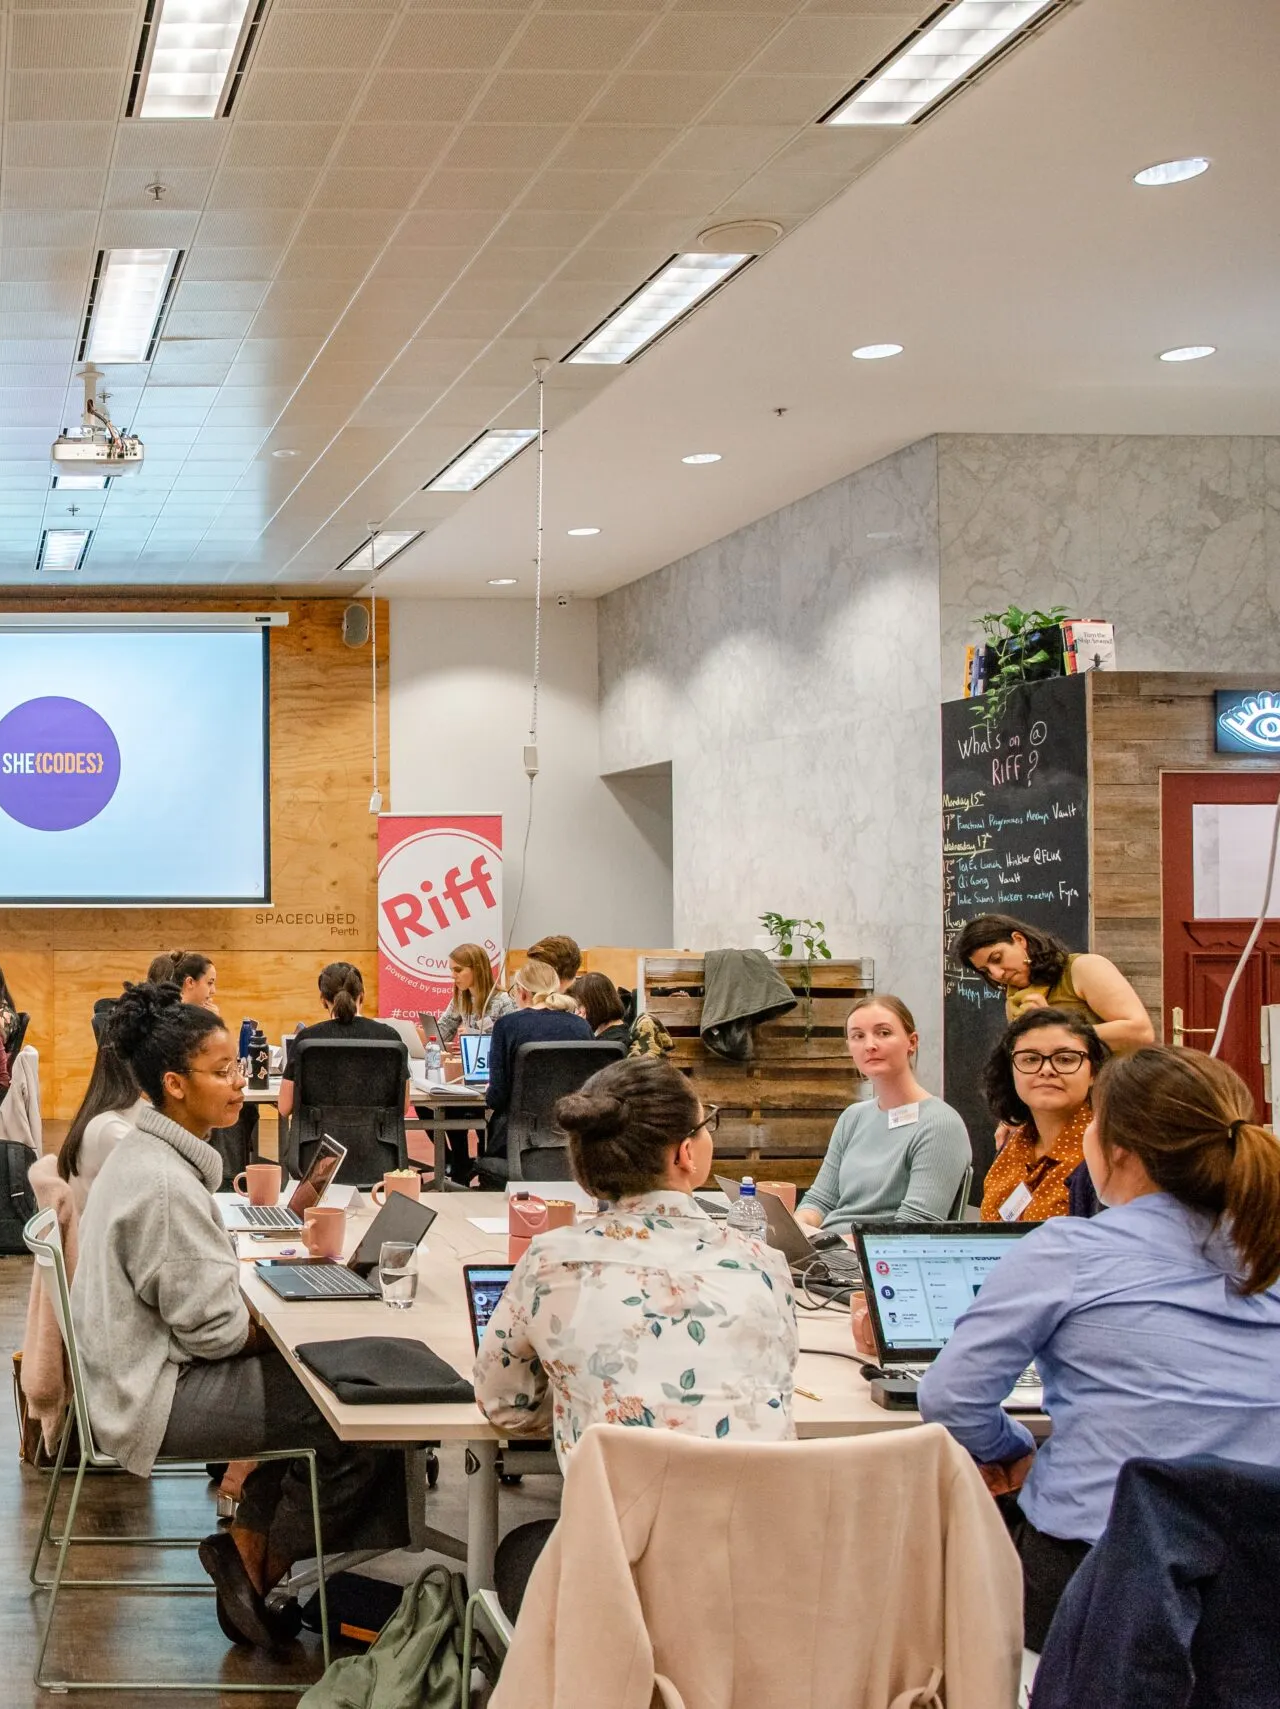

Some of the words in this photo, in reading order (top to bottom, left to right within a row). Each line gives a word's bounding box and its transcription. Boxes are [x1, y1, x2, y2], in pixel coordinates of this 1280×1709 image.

[1009, 735, 1020, 747] on
[2, 752, 104, 774] SHE{CODES}
[1051, 802, 1077, 820] Vault
[381, 855, 497, 948] Riff
[255, 913, 356, 925] SPACECUBED
[330, 926, 359, 936] Perth
[385, 963, 418, 988] powered
[419, 983, 430, 993] by
